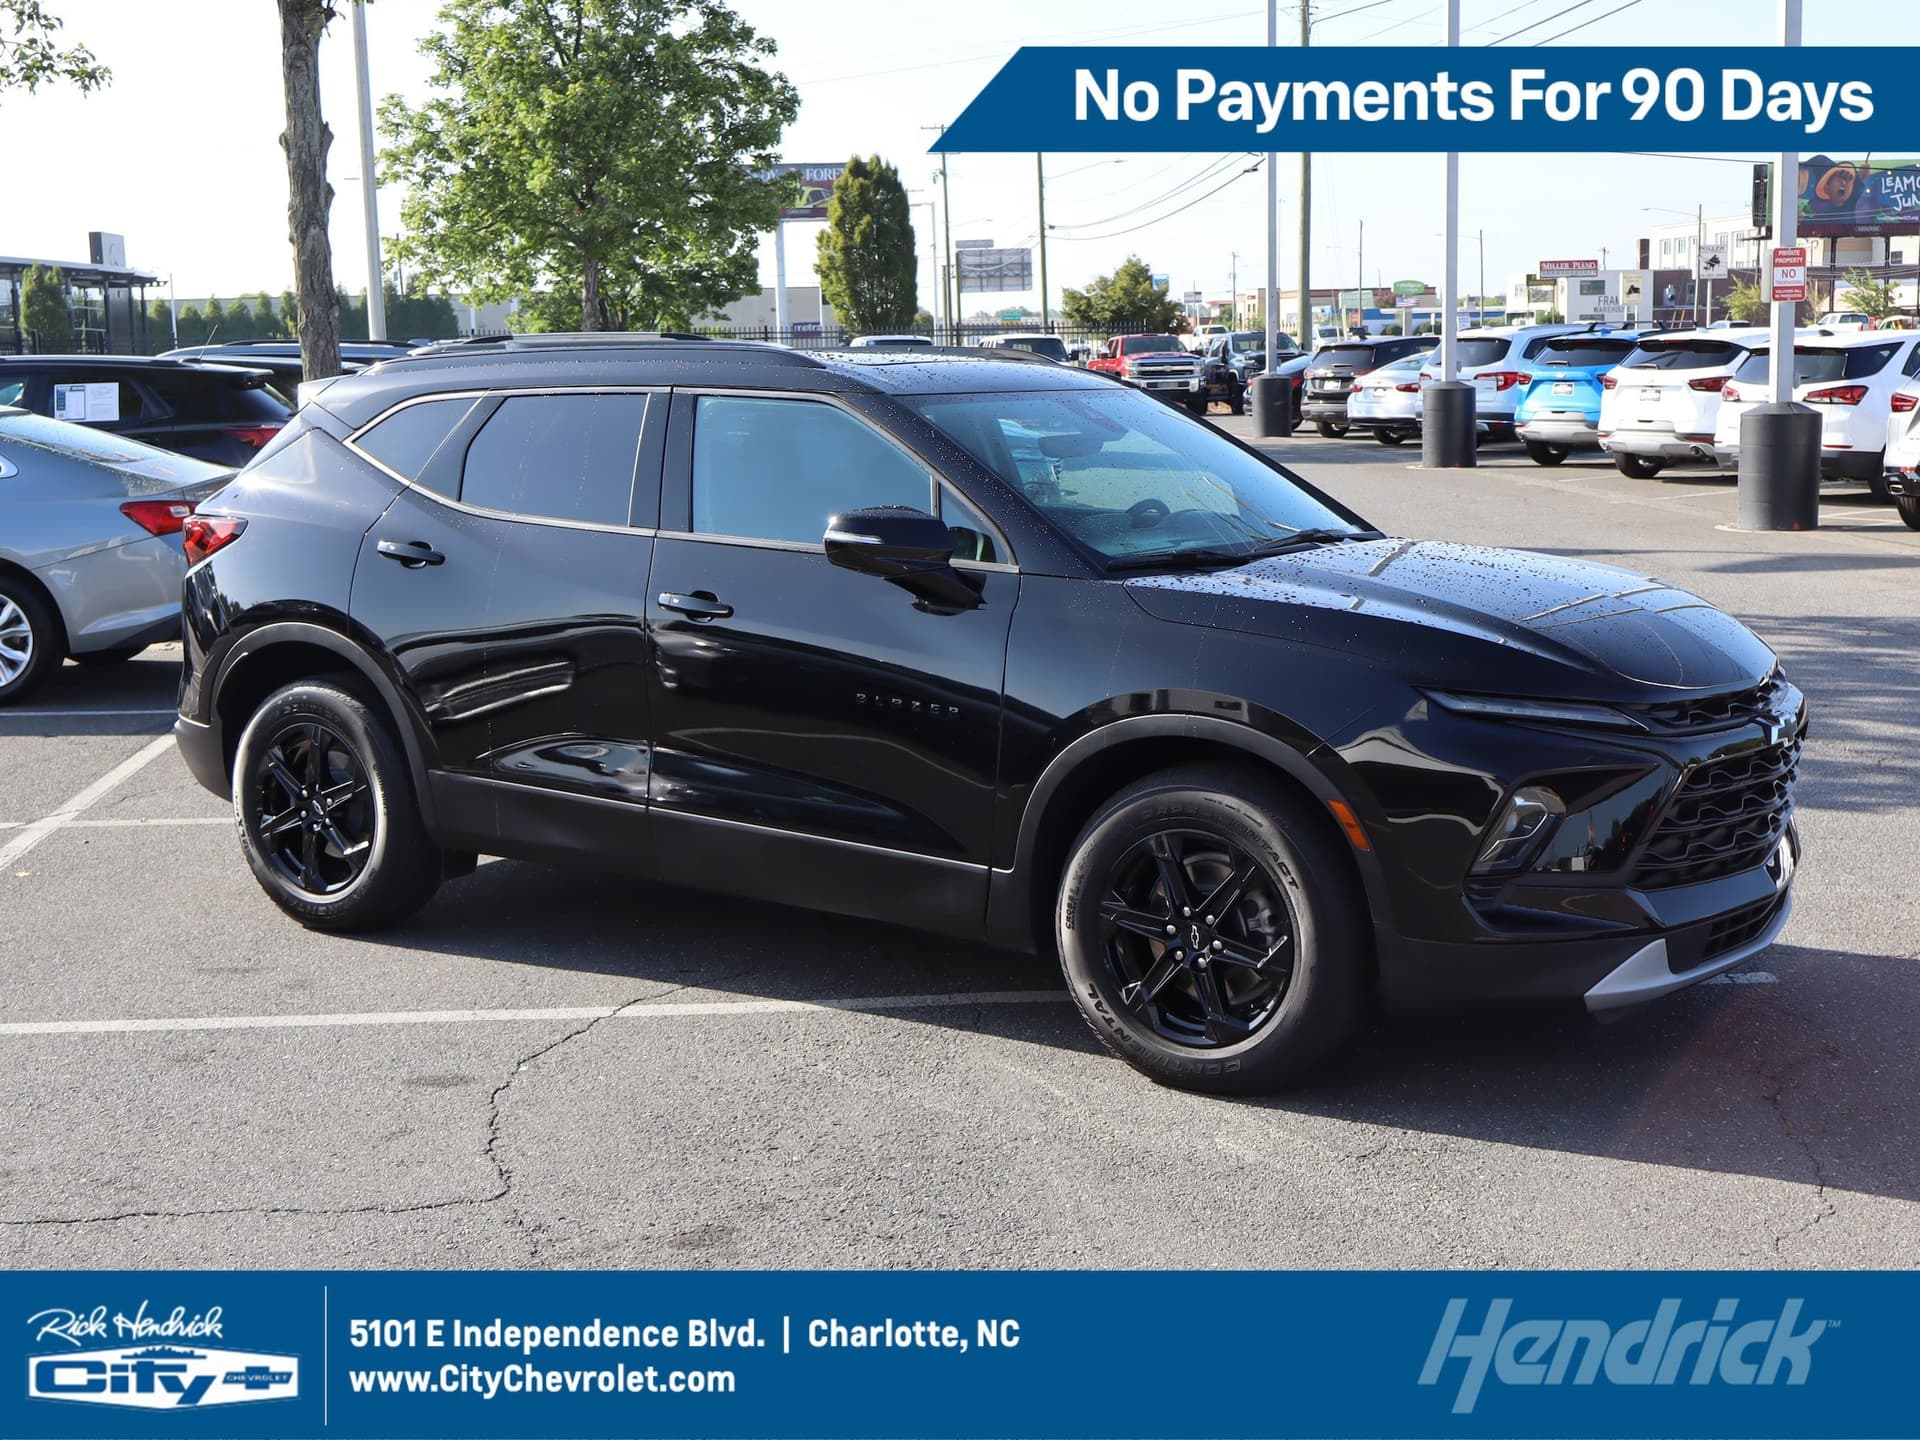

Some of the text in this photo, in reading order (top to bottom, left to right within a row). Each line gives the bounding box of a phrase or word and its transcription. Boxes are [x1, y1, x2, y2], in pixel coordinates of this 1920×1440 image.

[1542, 261, 1597, 270] MILLER PIANO
[1781, 268, 1797, 279] NO
[856, 692, 960, 717] BLAZER
